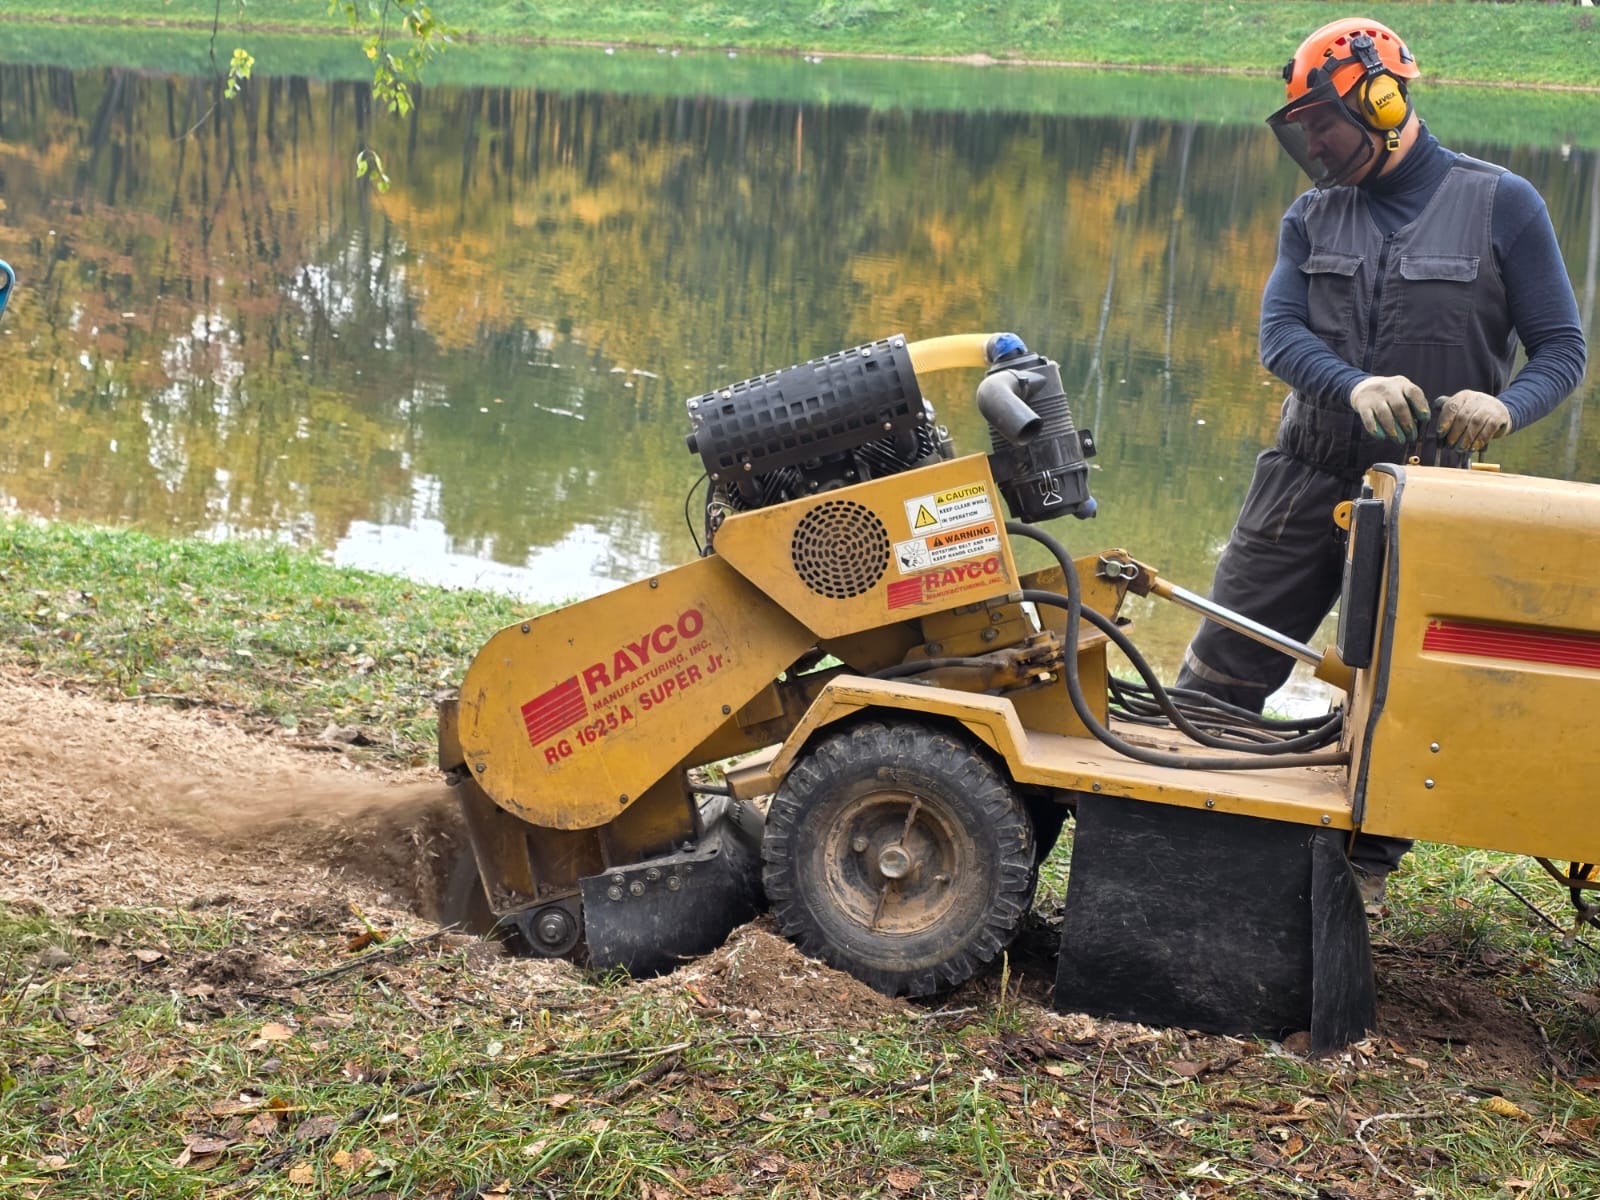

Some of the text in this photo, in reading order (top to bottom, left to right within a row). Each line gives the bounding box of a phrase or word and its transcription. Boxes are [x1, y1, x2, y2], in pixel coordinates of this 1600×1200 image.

[1375, 91, 1397, 106] uvex
[945, 485, 985, 501] CAUTION
[939, 497, 988, 514] KEEP CLEAR WHILE
[948, 510, 978, 522] OPERATION
[944, 526, 991, 544] WARNING
[967, 545, 985, 554] CLEAR
[925, 557, 1000, 590] RAYCO
[582, 608, 704, 696] RAYCO
[592, 639, 712, 711] MANUFACTURING, INC.
[543, 739, 573, 766] RG
[639, 664, 703, 711] SUPER
[706, 654, 732, 674] Jr.
